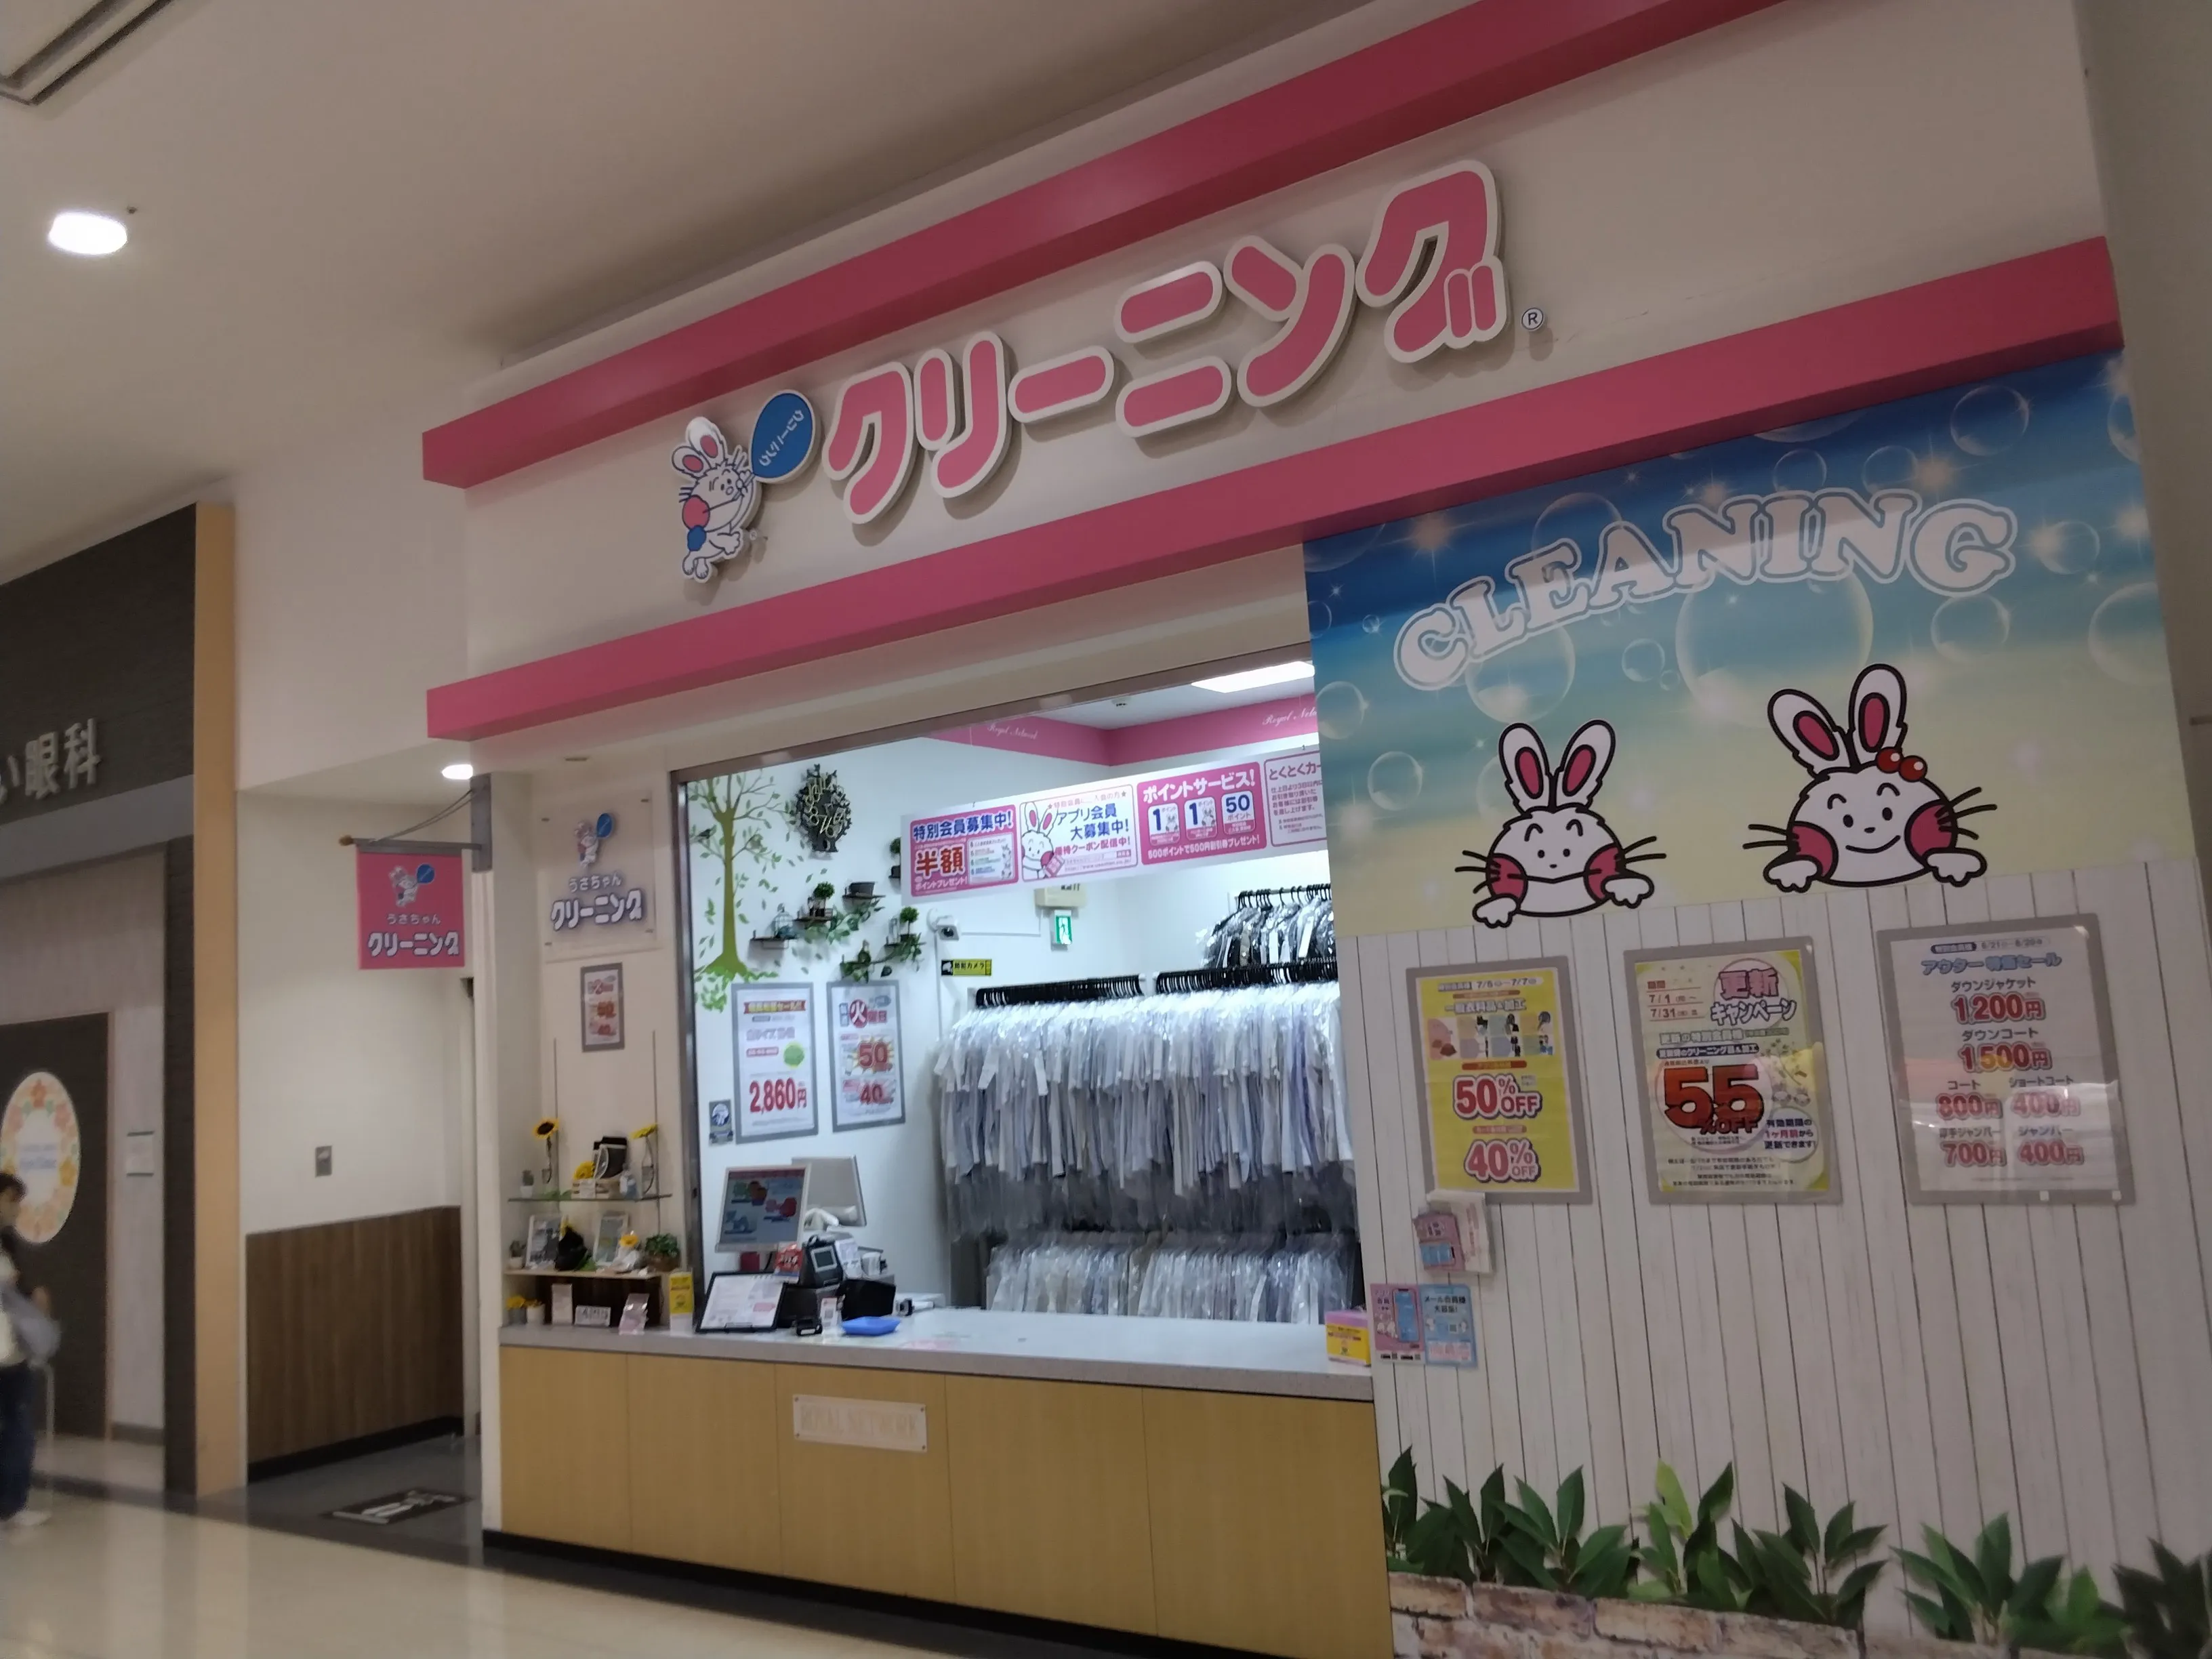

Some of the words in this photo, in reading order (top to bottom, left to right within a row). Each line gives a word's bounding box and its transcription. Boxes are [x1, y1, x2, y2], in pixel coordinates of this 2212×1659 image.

[823, 160, 1507, 525] クリーニング
[1394, 488, 2017, 691] CLEANING
[1189, 802, 1198, 825] 1
[1225, 794, 1250, 813] 50
[1153, 808, 1162, 831] 1
[915, 845, 964, 878] 半額
[568, 874, 621, 893] うさちゃん
[387, 914, 441, 925] うさちゃん
[551, 888, 643, 931] クリーニング
[367, 930, 460, 957] クリーニング
[1951, 977, 2036, 993] ダウンジャケット
[1710, 998, 1797, 1026] キャンペーン
[1961, 1027, 2039, 1042] ダウンコート
[1947, 1079, 1981, 1090] コート
[2009, 1076, 2074, 1088] ショートコート
[1663, 1064, 1765, 1129] 55
[1942, 1141, 2006, 1166] 700円
[2018, 1140, 2084, 1165] 400円
